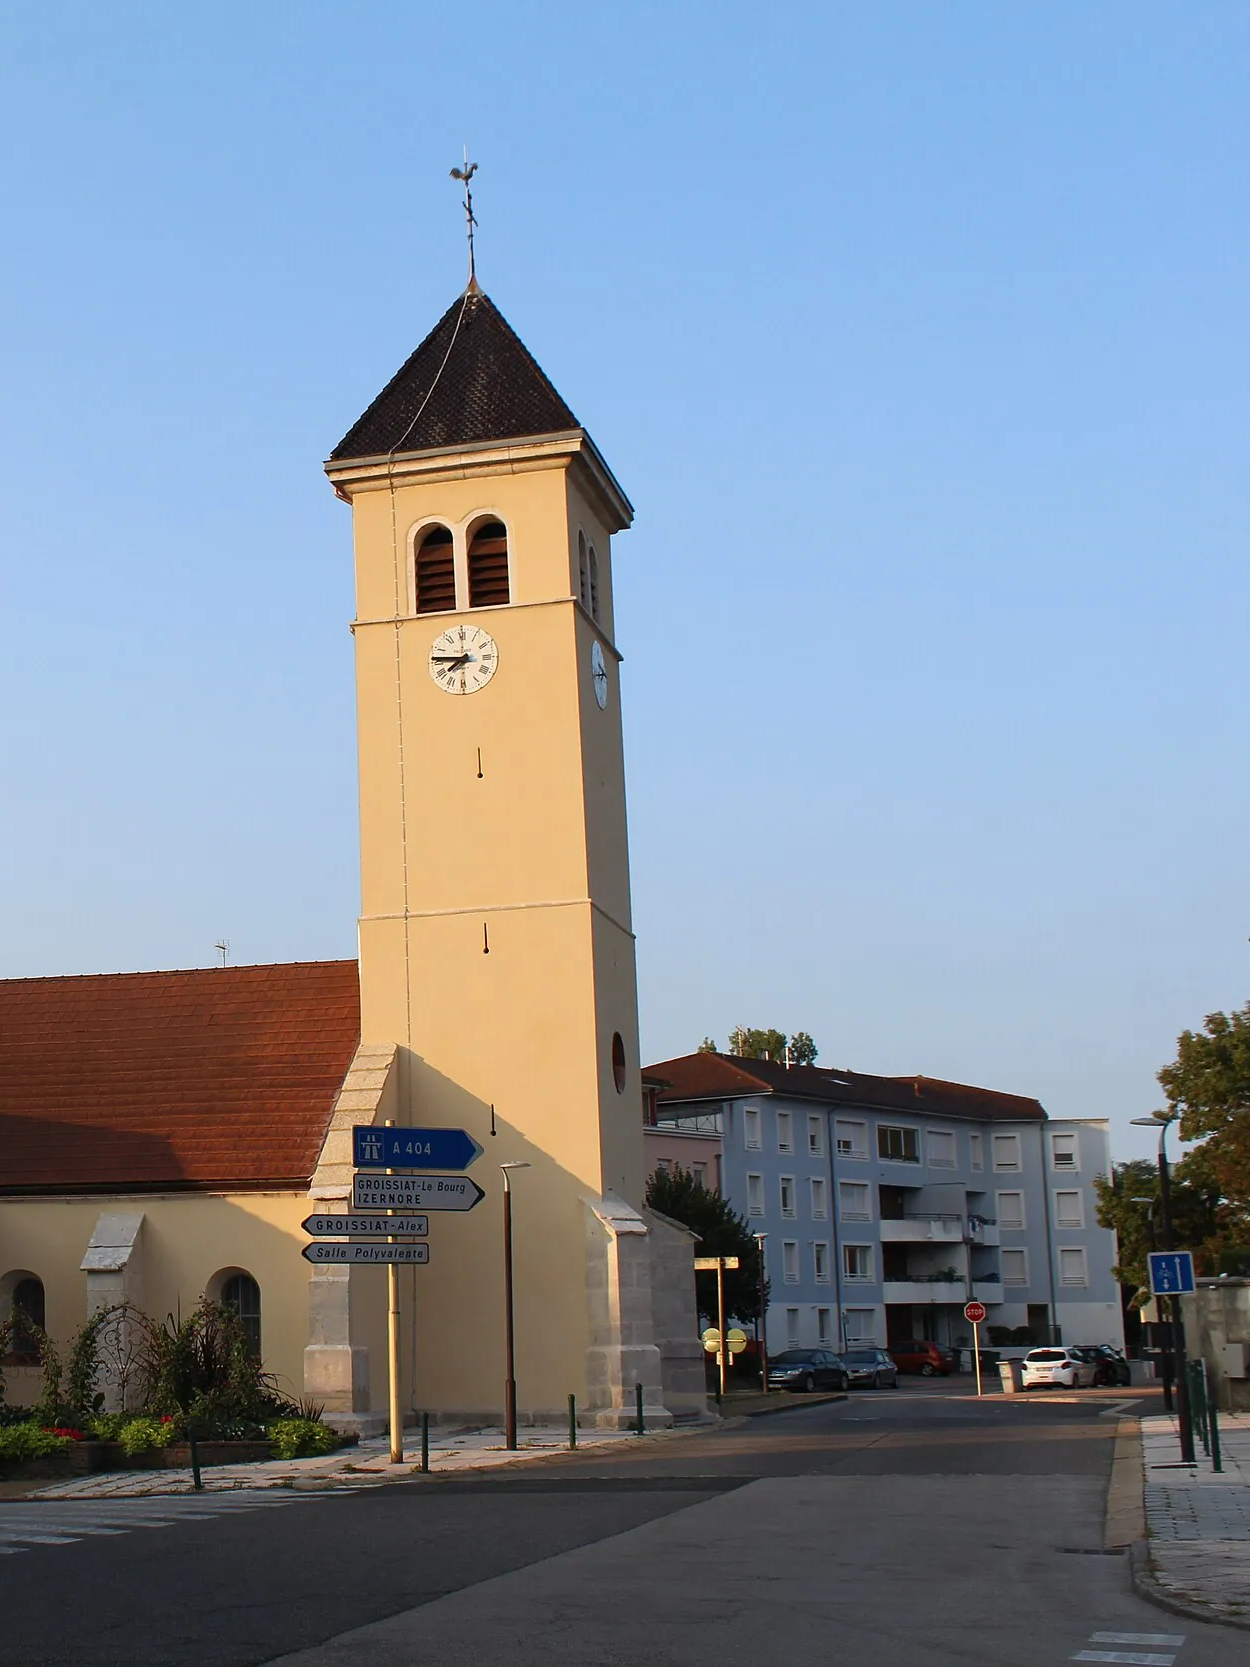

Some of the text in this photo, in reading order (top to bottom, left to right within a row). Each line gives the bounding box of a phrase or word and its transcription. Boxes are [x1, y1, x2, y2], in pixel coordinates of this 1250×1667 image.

[393, 1142, 431, 1155] A 404
[358, 1180, 466, 1194] GROISSIAT-Le Bourg
[358, 1193, 421, 1204] IZERNORE
[316, 1220, 423, 1231] GROISSIAT-Alex
[316, 1247, 423, 1260] Salle Polyvalente
